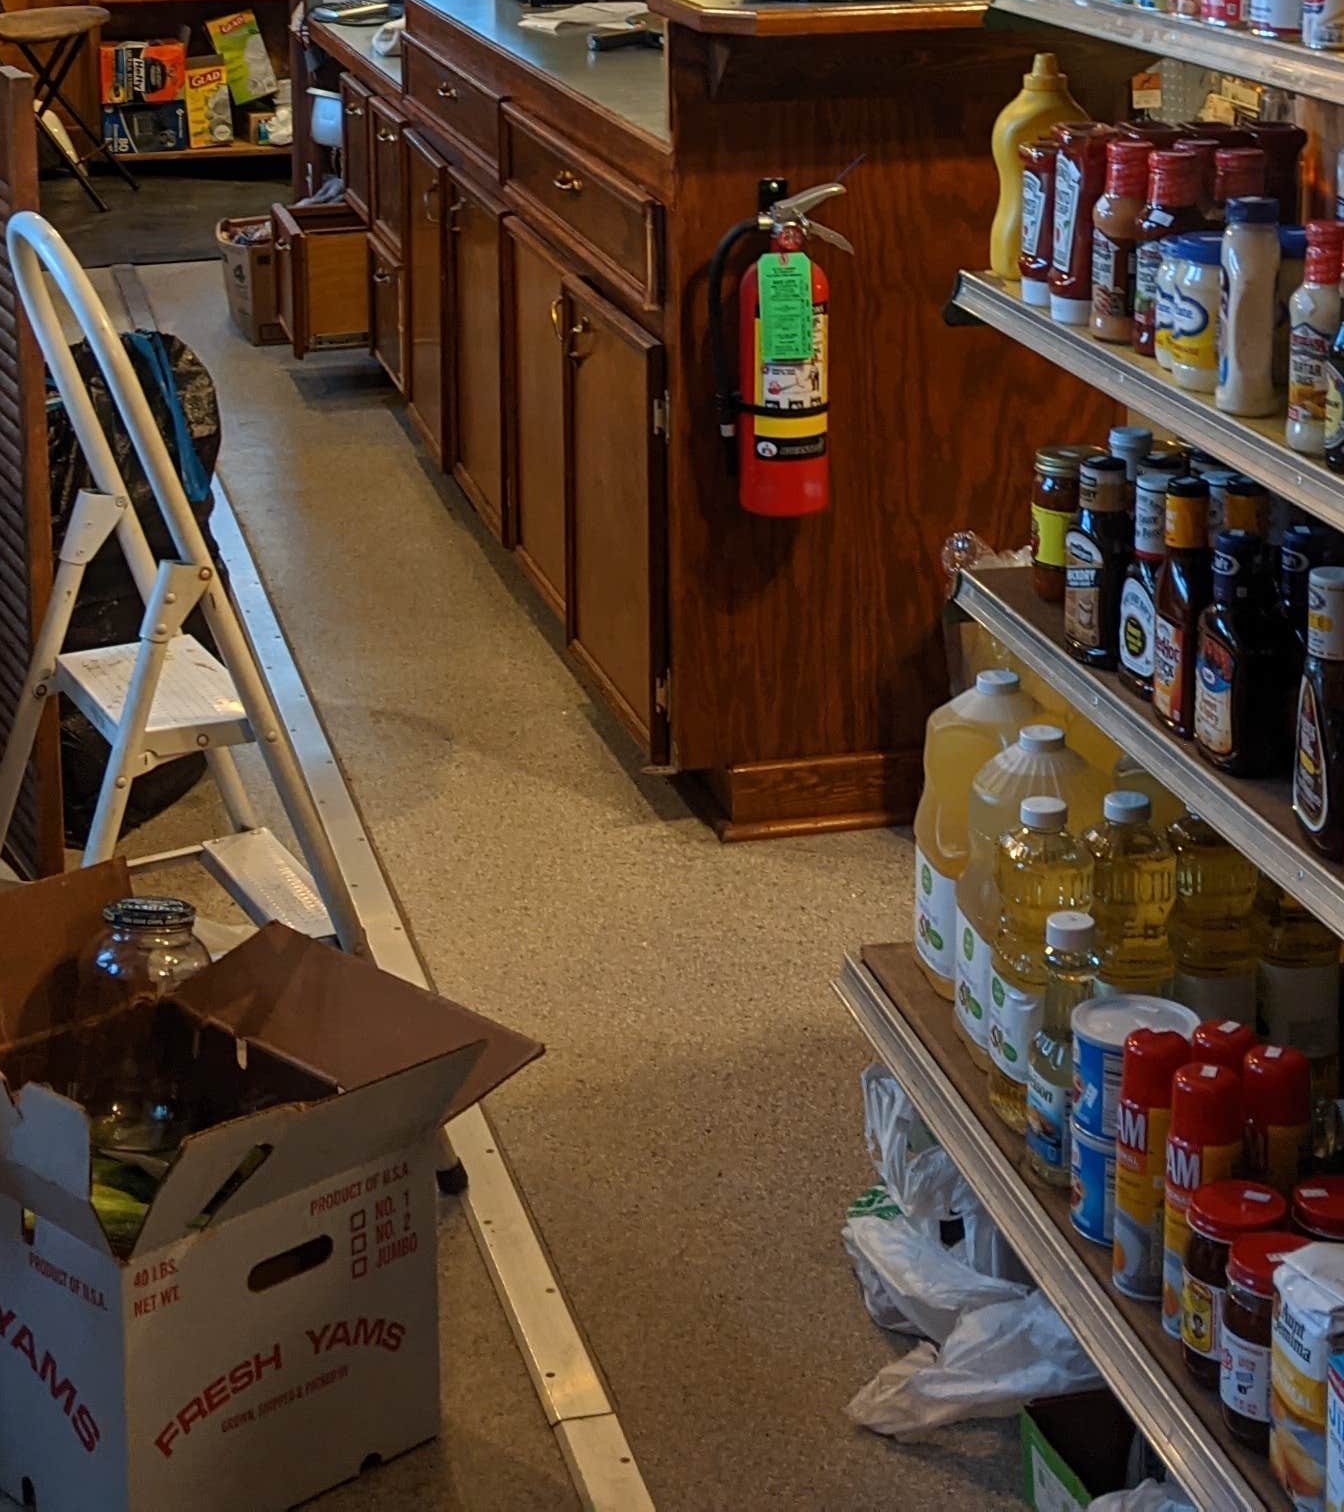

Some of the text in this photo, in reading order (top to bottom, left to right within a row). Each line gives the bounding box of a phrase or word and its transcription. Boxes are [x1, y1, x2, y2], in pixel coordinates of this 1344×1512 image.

[220, 13, 245, 33] GLAD
[133, 60, 145, 91] Hefty
[191, 70, 221, 87] GLAD
[1118, 1101, 1147, 1153] AM
[1166, 1140, 1201, 1191] AM
[309, 1182, 360, 1218] PRODUCT
[363, 1173, 379, 1202] OF
[374, 1191, 411, 1226] NO. 1
[374, 1213, 413, 1246] NO. 2
[374, 1232, 420, 1269] JUMBO
[132, 1294, 157, 1318] NET
[1281, 1301, 1306, 1340] Aunt
[153, 1317, 407, 1459] FRESH YAMS
